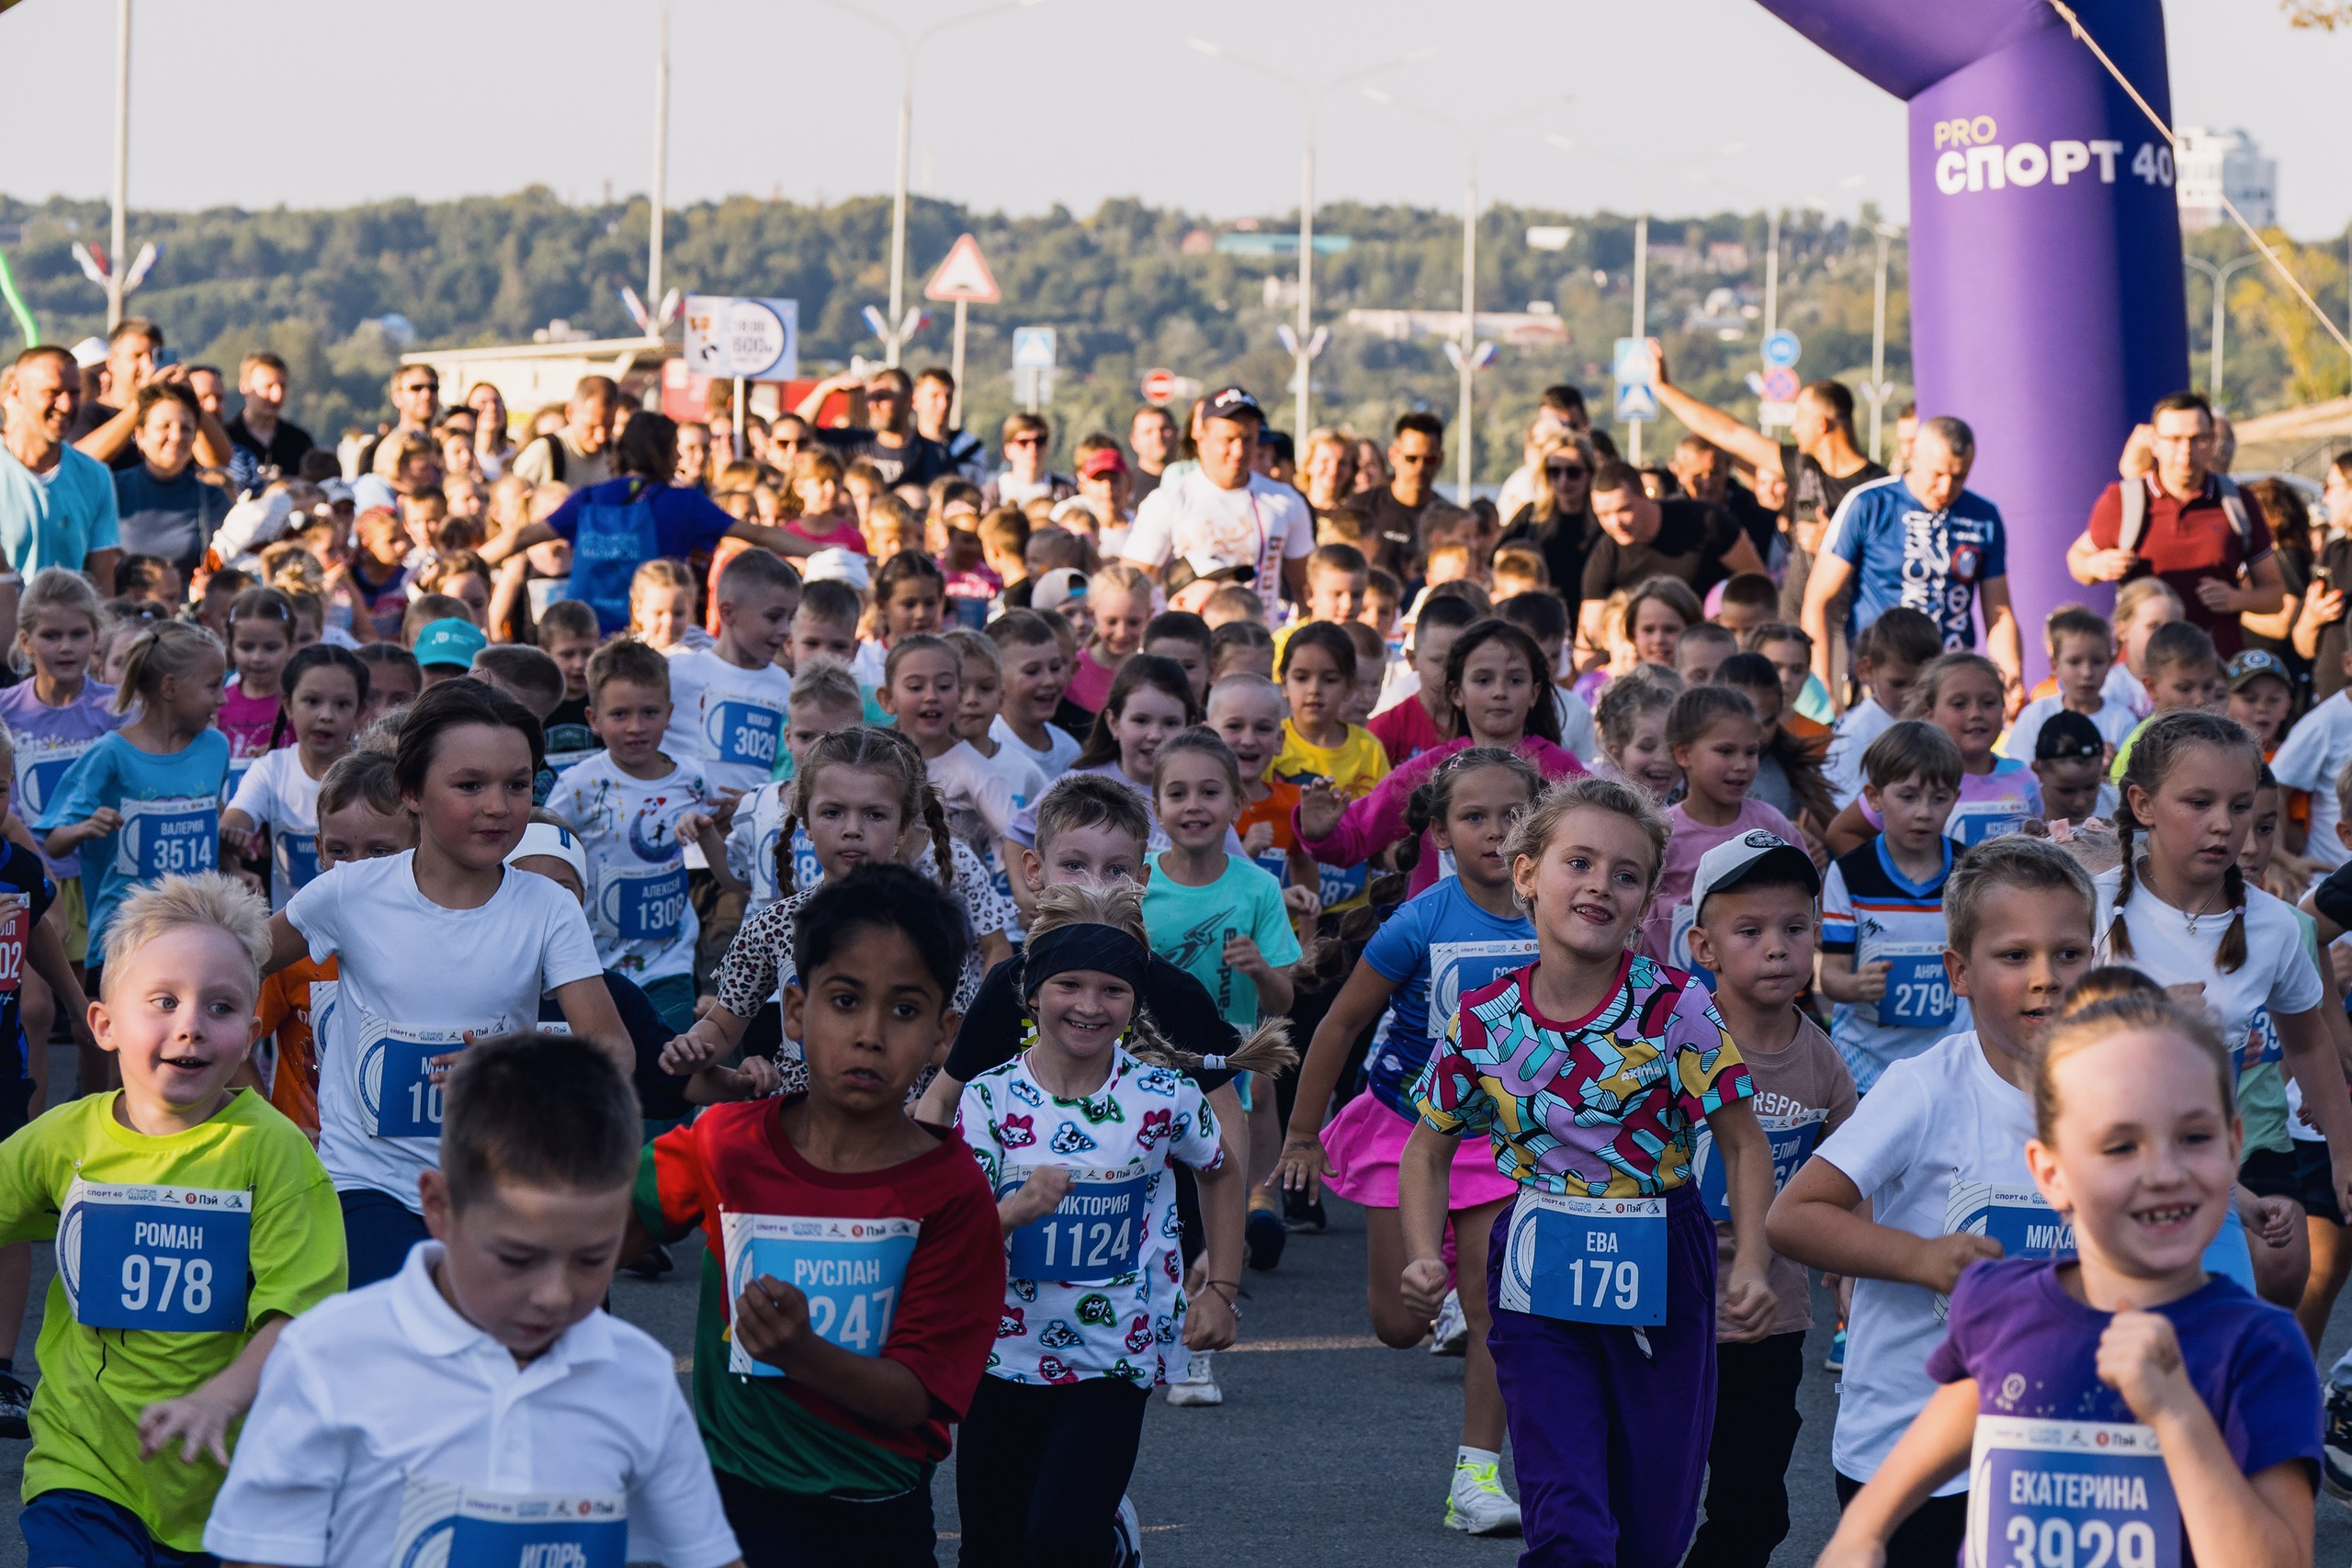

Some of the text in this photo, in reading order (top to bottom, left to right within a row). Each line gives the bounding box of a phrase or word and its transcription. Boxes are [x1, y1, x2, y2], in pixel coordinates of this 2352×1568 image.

[1934, 115, 1997, 151] PRO
[1935, 140, 2175, 196] СПОРТ 40
[161, 818, 205, 837] ВАЛЕРИЯ
[153, 835, 212, 870] 3514
[641, 875, 682, 898] АЛЕКСЕЙ
[1894, 982, 1954, 1017] 2794
[390, 1028, 408, 1037] СПОРТ
[475, 1027, 489, 1038] Пэй
[1115, 1170, 1131, 1180] Пэй
[86, 1190, 113, 1198] СПОРТ
[198, 1194, 219, 1205] Пэй
[1053, 1193, 1131, 1217] ИКТОРИЯ
[1541, 1197, 1558, 1206] СПОРТ
[1626, 1203, 1642, 1213] Пэй
[134, 1221, 204, 1250] РОМАН
[865, 1224, 886, 1236] Пэй
[1043, 1217, 1132, 1267] 1124
[1586, 1231, 1619, 1253] ЕВА
[120, 1254, 213, 1314] 978
[794, 1258, 881, 1286] РУСЛАН
[1568, 1258, 1640, 1310] 179
[808, 1285, 895, 1350] 247
[2112, 1433, 2137, 1447] Пэй
[2009, 1469, 2149, 1511] ЕКАТЕРИНА
[2005, 1516, 2156, 1568] 3929
[518, 1542, 589, 1568] ИГОРЬ
